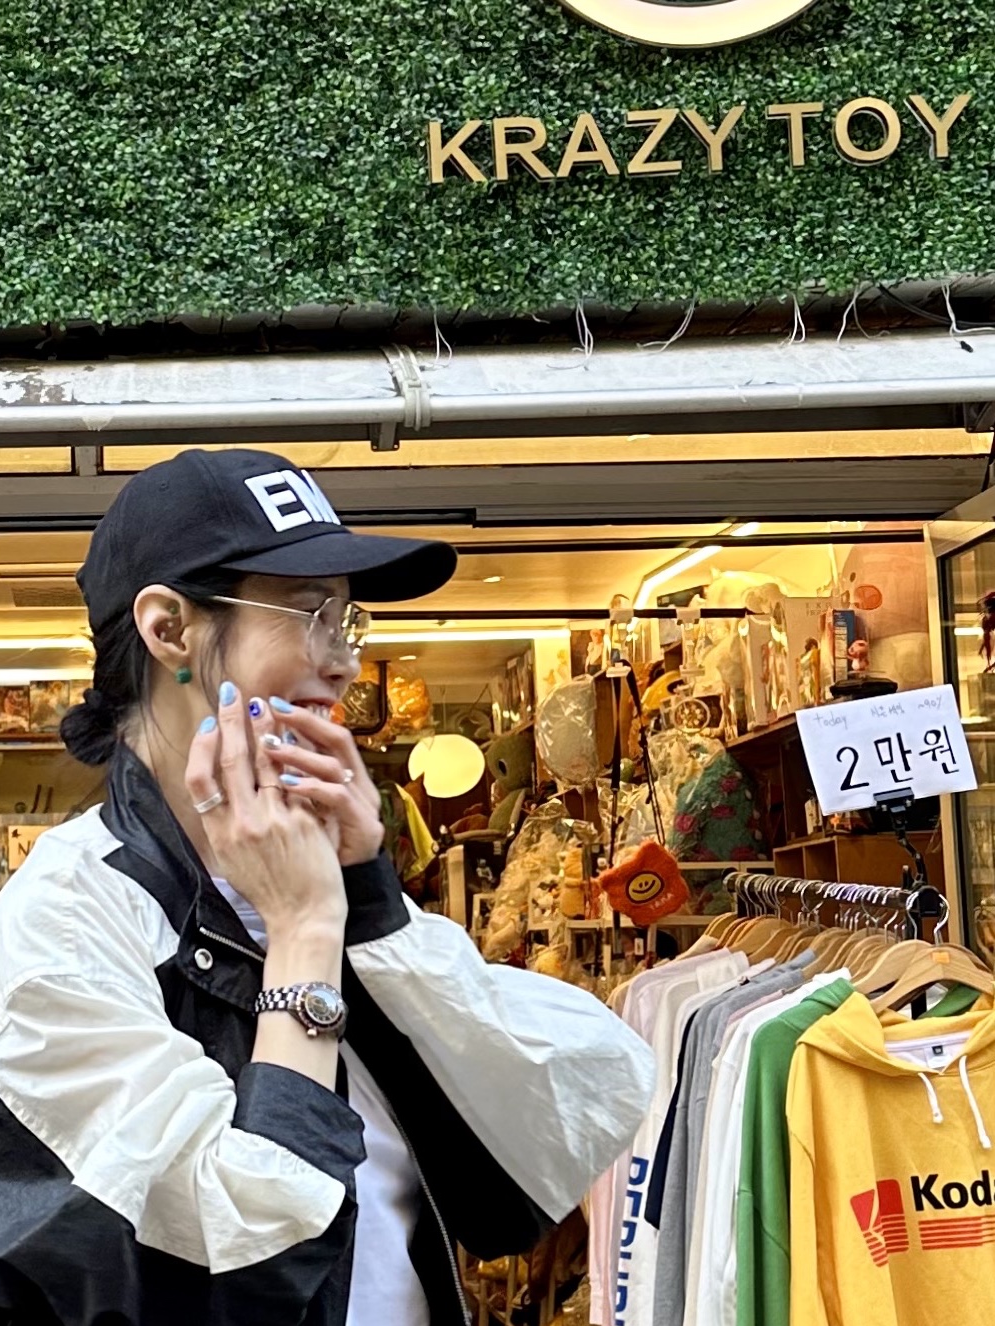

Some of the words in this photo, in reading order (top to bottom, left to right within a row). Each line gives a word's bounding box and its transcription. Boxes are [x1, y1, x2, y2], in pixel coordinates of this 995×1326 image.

[427, 105, 746, 184] KRAZY
[766, 94, 971, 168] TOY
[910, 1169, 995, 1212] Kod
